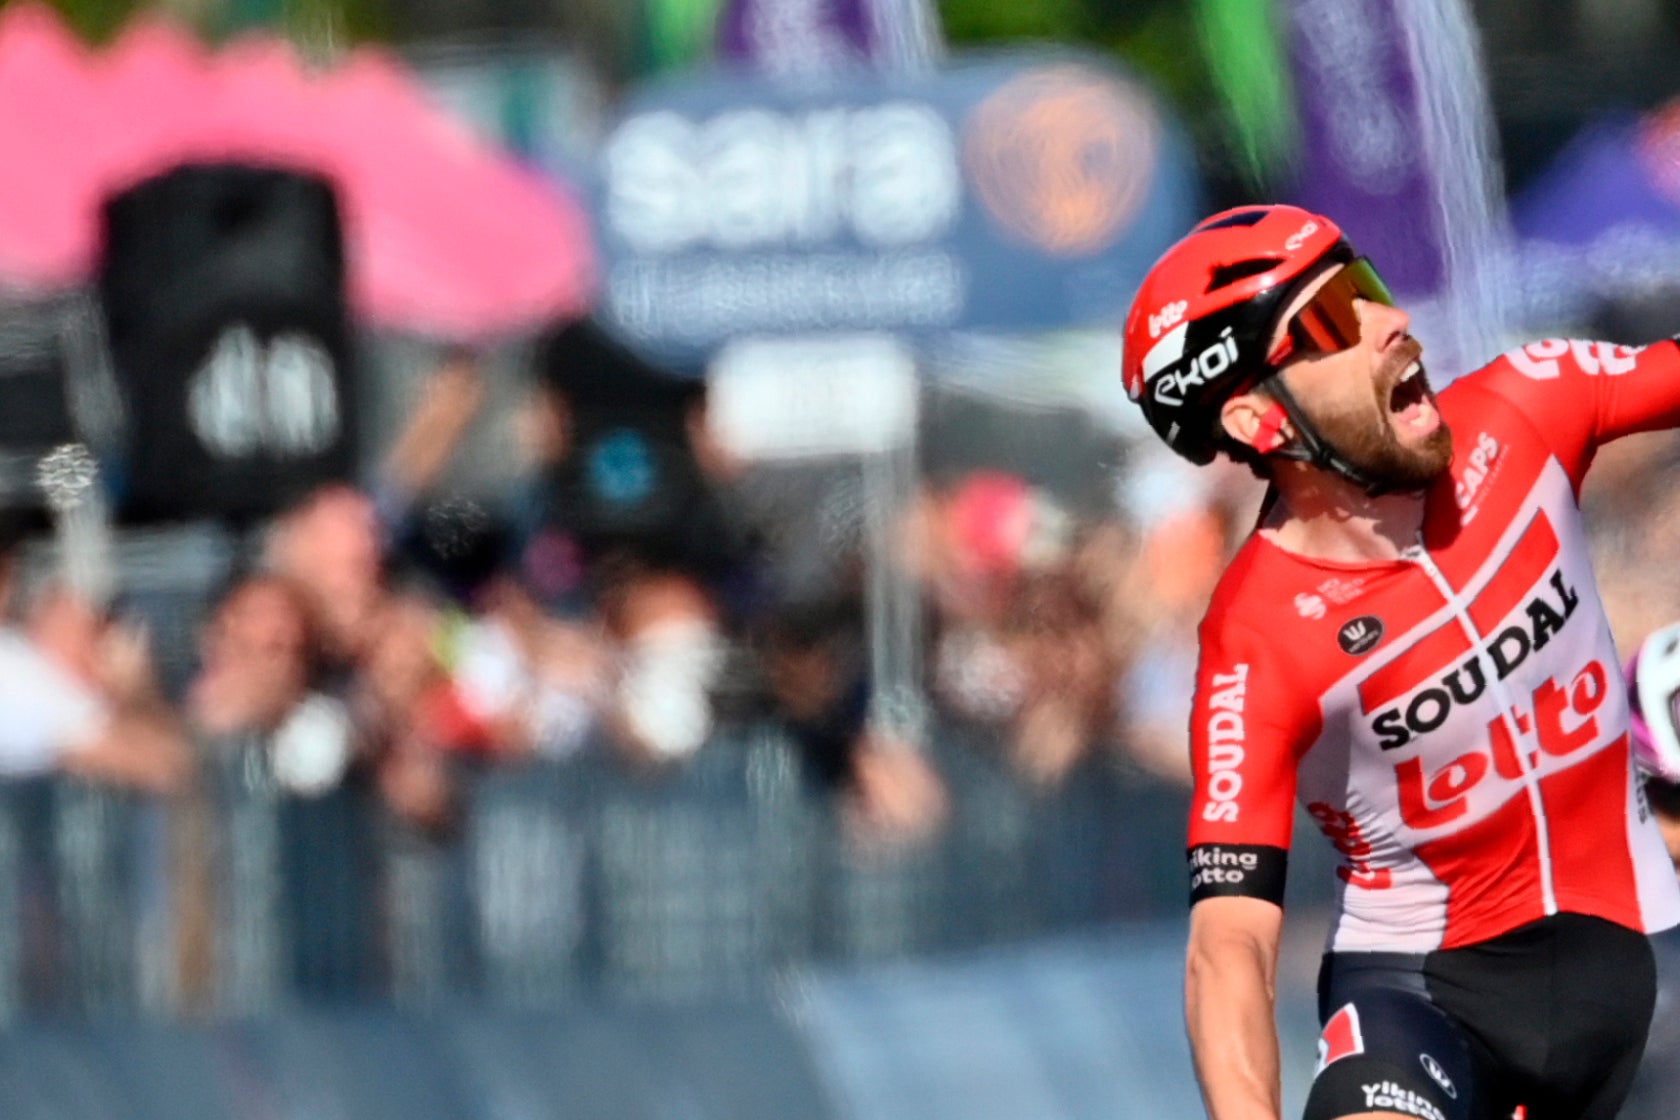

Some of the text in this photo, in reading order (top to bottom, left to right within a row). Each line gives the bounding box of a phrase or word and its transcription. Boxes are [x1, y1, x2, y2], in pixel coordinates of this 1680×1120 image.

[1202, 662, 1250, 824] SOUDAL
[1372, 568, 1580, 752] SOUDAL
[1394, 660, 1608, 830] lotto
[1191, 867, 1244, 890] otto
